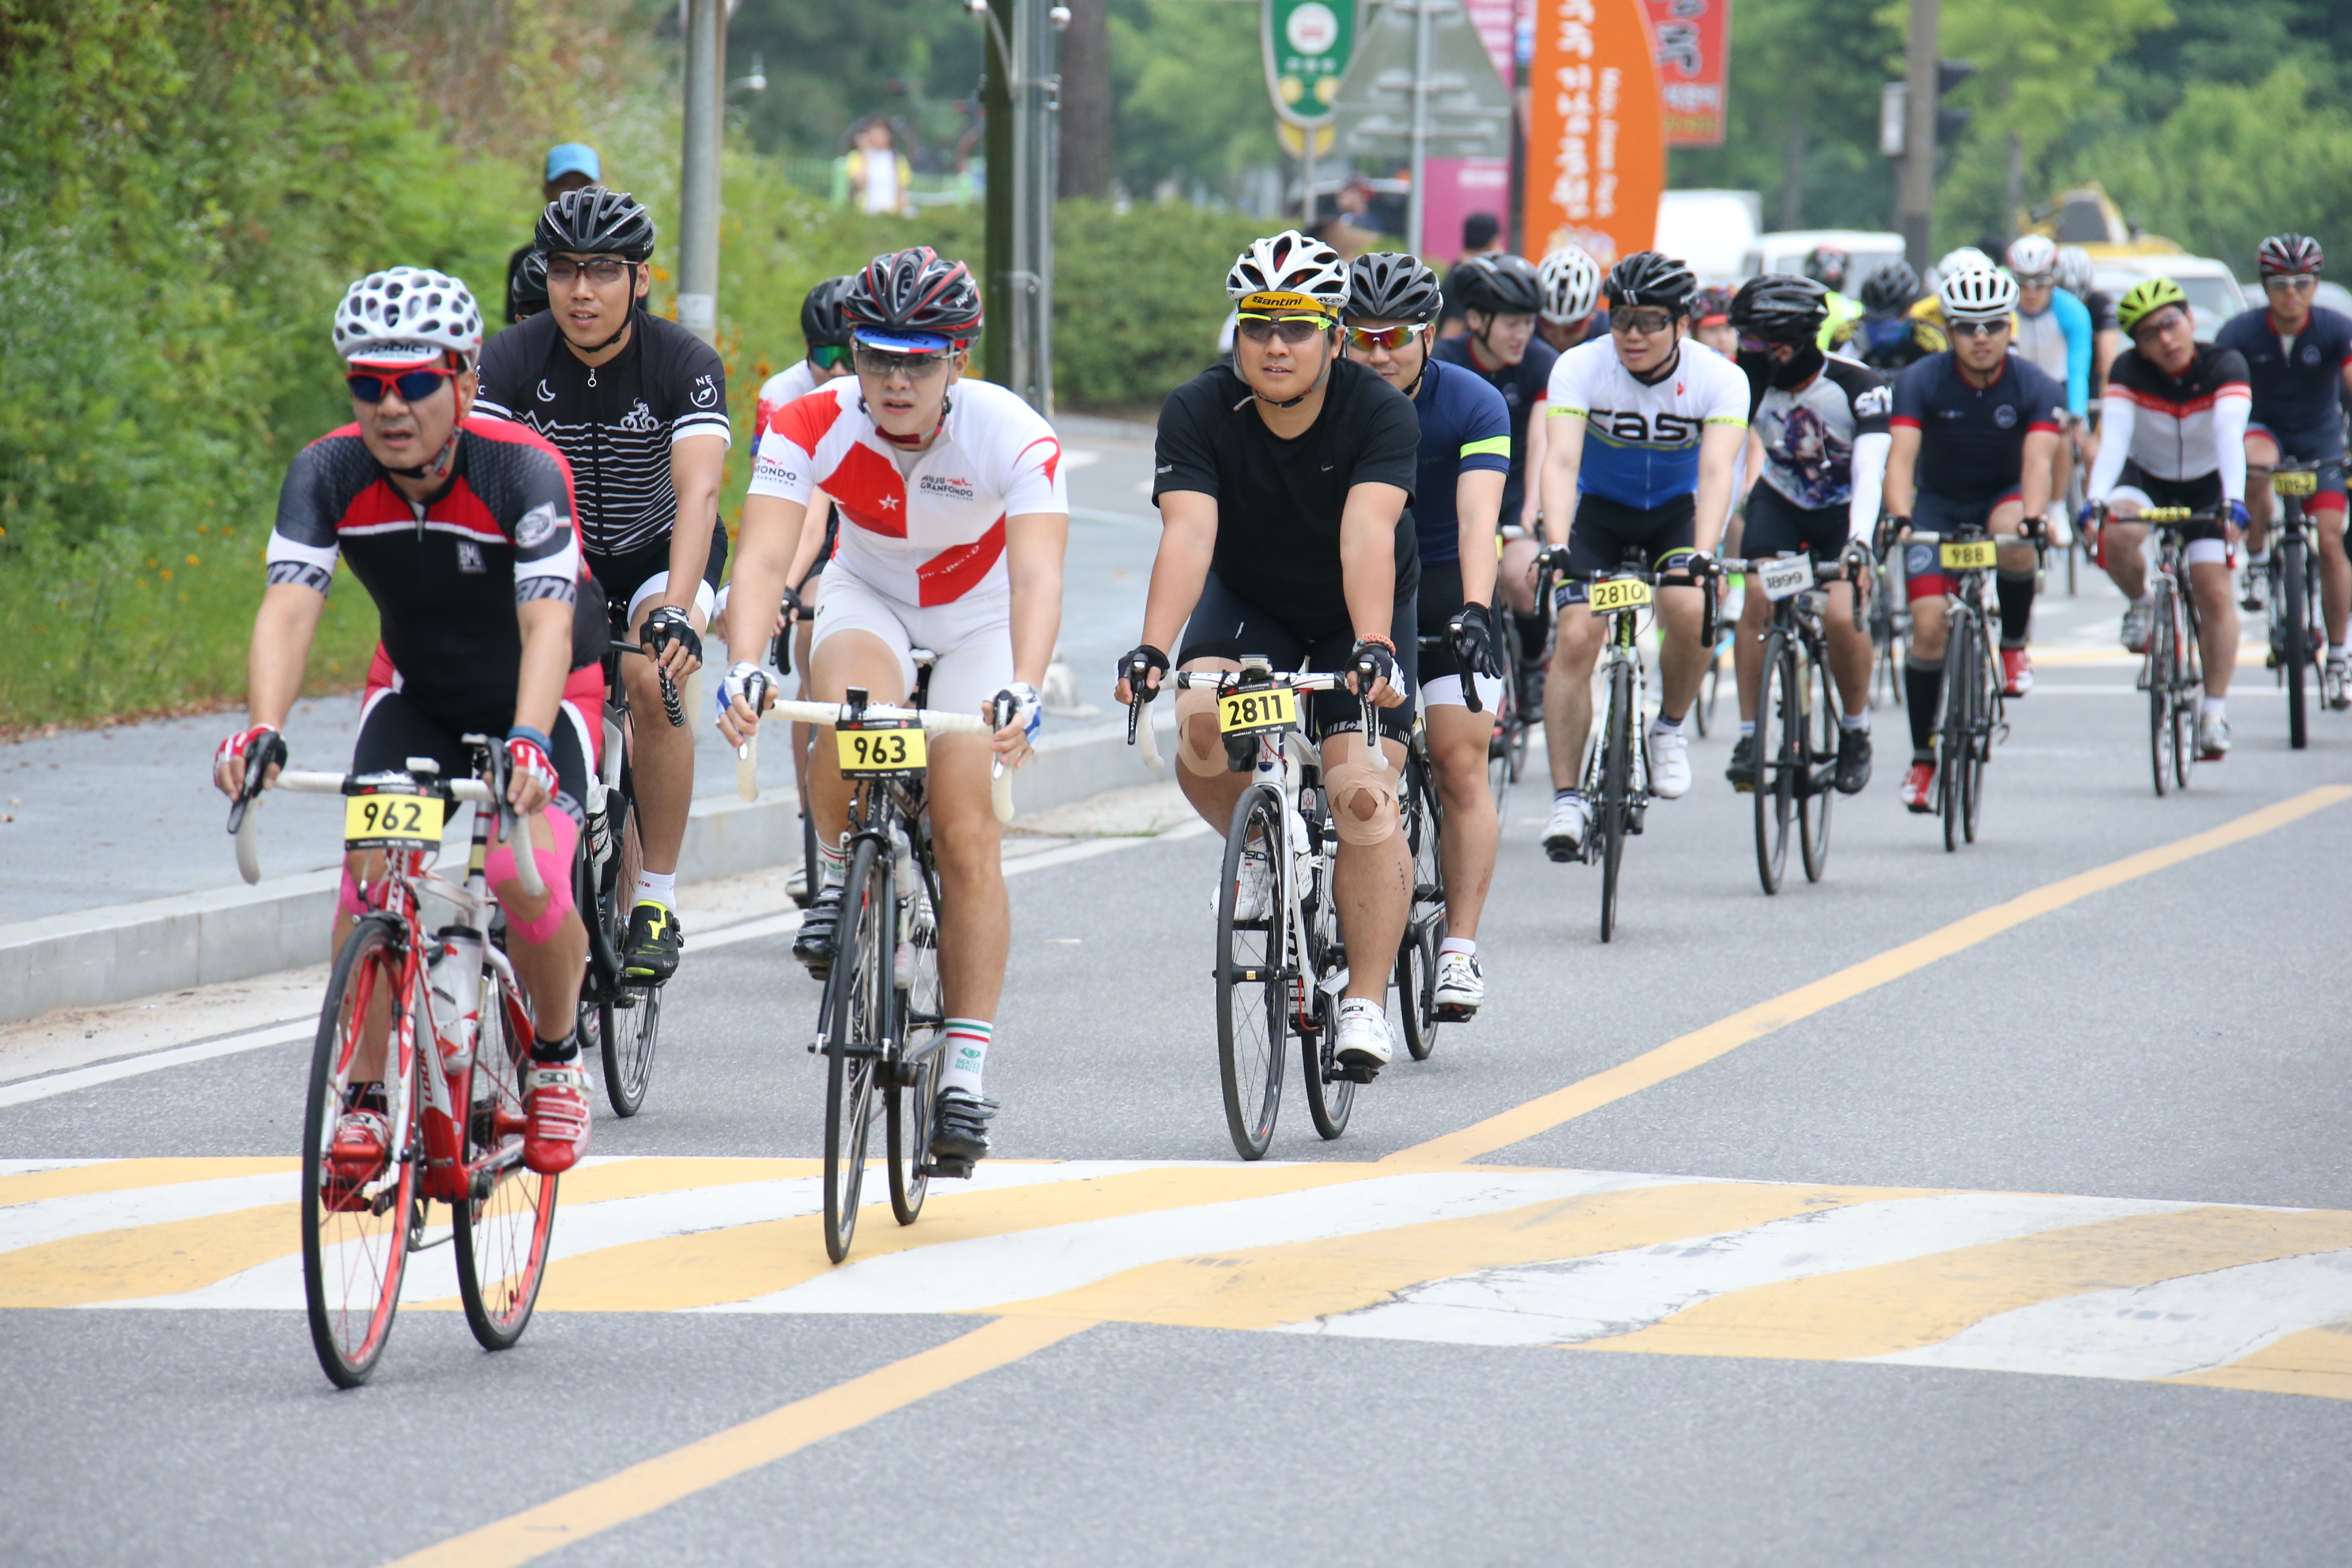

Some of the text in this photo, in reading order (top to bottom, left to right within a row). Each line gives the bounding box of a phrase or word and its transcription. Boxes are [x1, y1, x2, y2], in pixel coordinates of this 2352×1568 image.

[1252, 295, 1303, 306] Santini
[696, 374, 713, 386] NE
[920, 482, 973, 497] GRANFONDO
[1952, 547, 1984, 564] 988
[1766, 571, 1803, 589] 1899
[1596, 583, 1642, 606] 2810
[1130, 693, 1139, 731] ULTEGRA
[1227, 694, 1283, 727] 2811
[1365, 694, 1374, 732] ULTEGRA
[854, 736, 906, 764] 963
[364, 802, 421, 832] 962
[419, 1048, 434, 1102] LOOK
